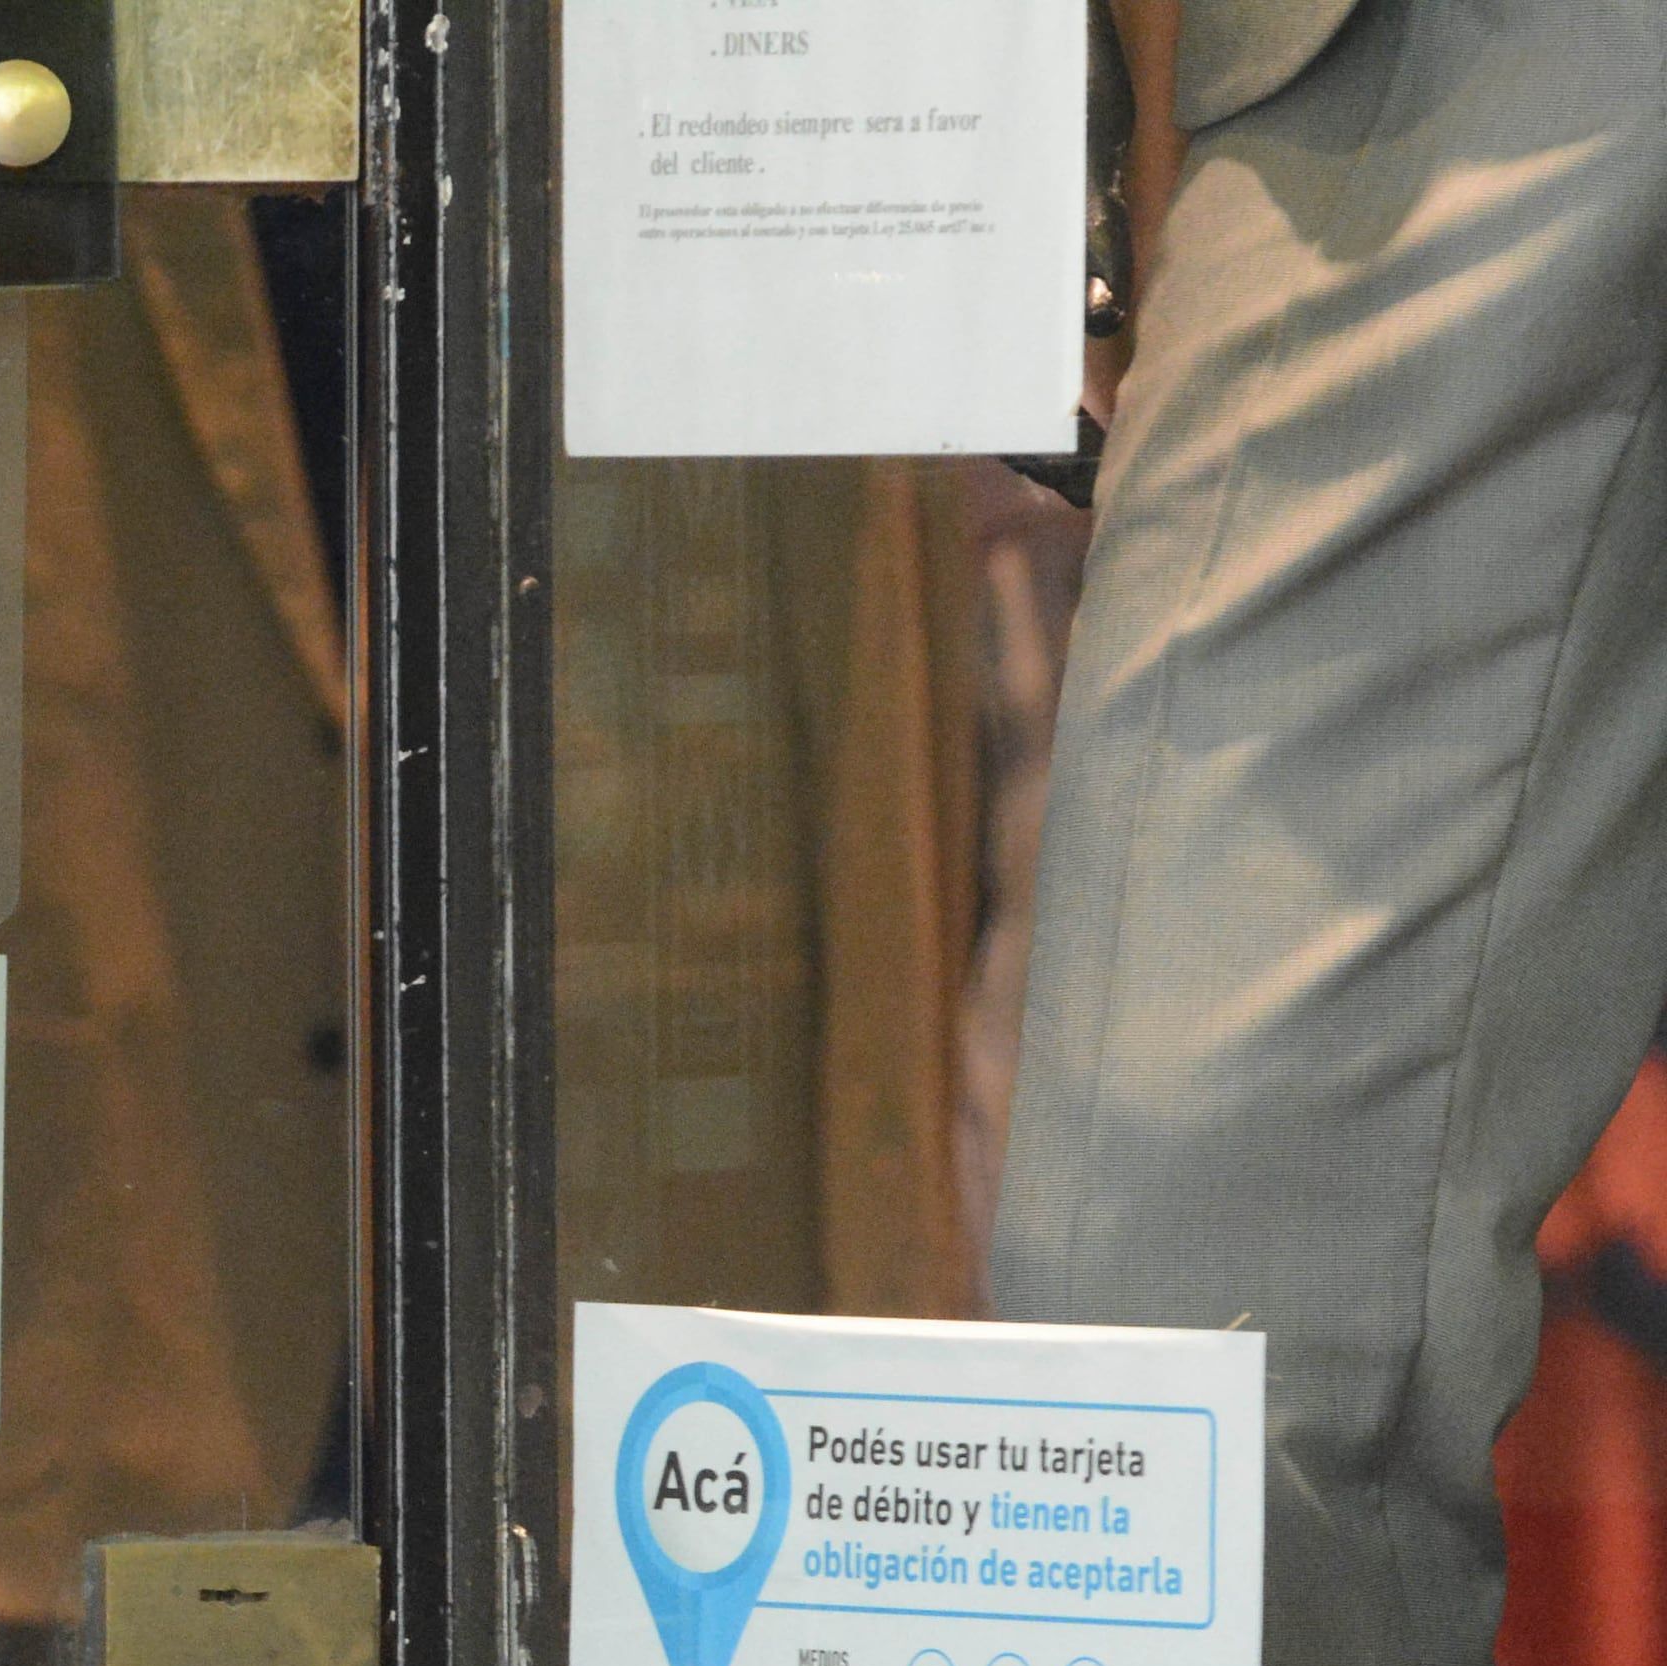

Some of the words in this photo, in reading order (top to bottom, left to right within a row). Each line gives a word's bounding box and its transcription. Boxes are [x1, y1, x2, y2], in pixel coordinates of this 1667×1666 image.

[724, 30, 809, 57] DINERS
[651, 113, 671, 138] El
[678, 112, 768, 138] redondeo
[773, 111, 853, 140] siempre
[864, 115, 903, 133] sera
[910, 116, 922, 132] a
[927, 108, 981, 132] favor
[650, 150, 679, 176] del
[807, 1425, 905, 1466] Podés
[916, 1440, 987, 1471] usar
[998, 1437, 1028, 1472] tu
[1039, 1438, 1145, 1483] tarjeta
[652, 1450, 750, 1515] Acá
[806, 1483, 843, 1521] de
[853, 1485, 952, 1526] débito
[963, 1500, 981, 1536] y
[990, 1492, 1091, 1533] tienen
[1100, 1496, 1130, 1536] la
[803, 1541, 968, 1590] obligación
[979, 1549, 1018, 1588] de
[1028, 1556, 1183, 1600] aceptarla
